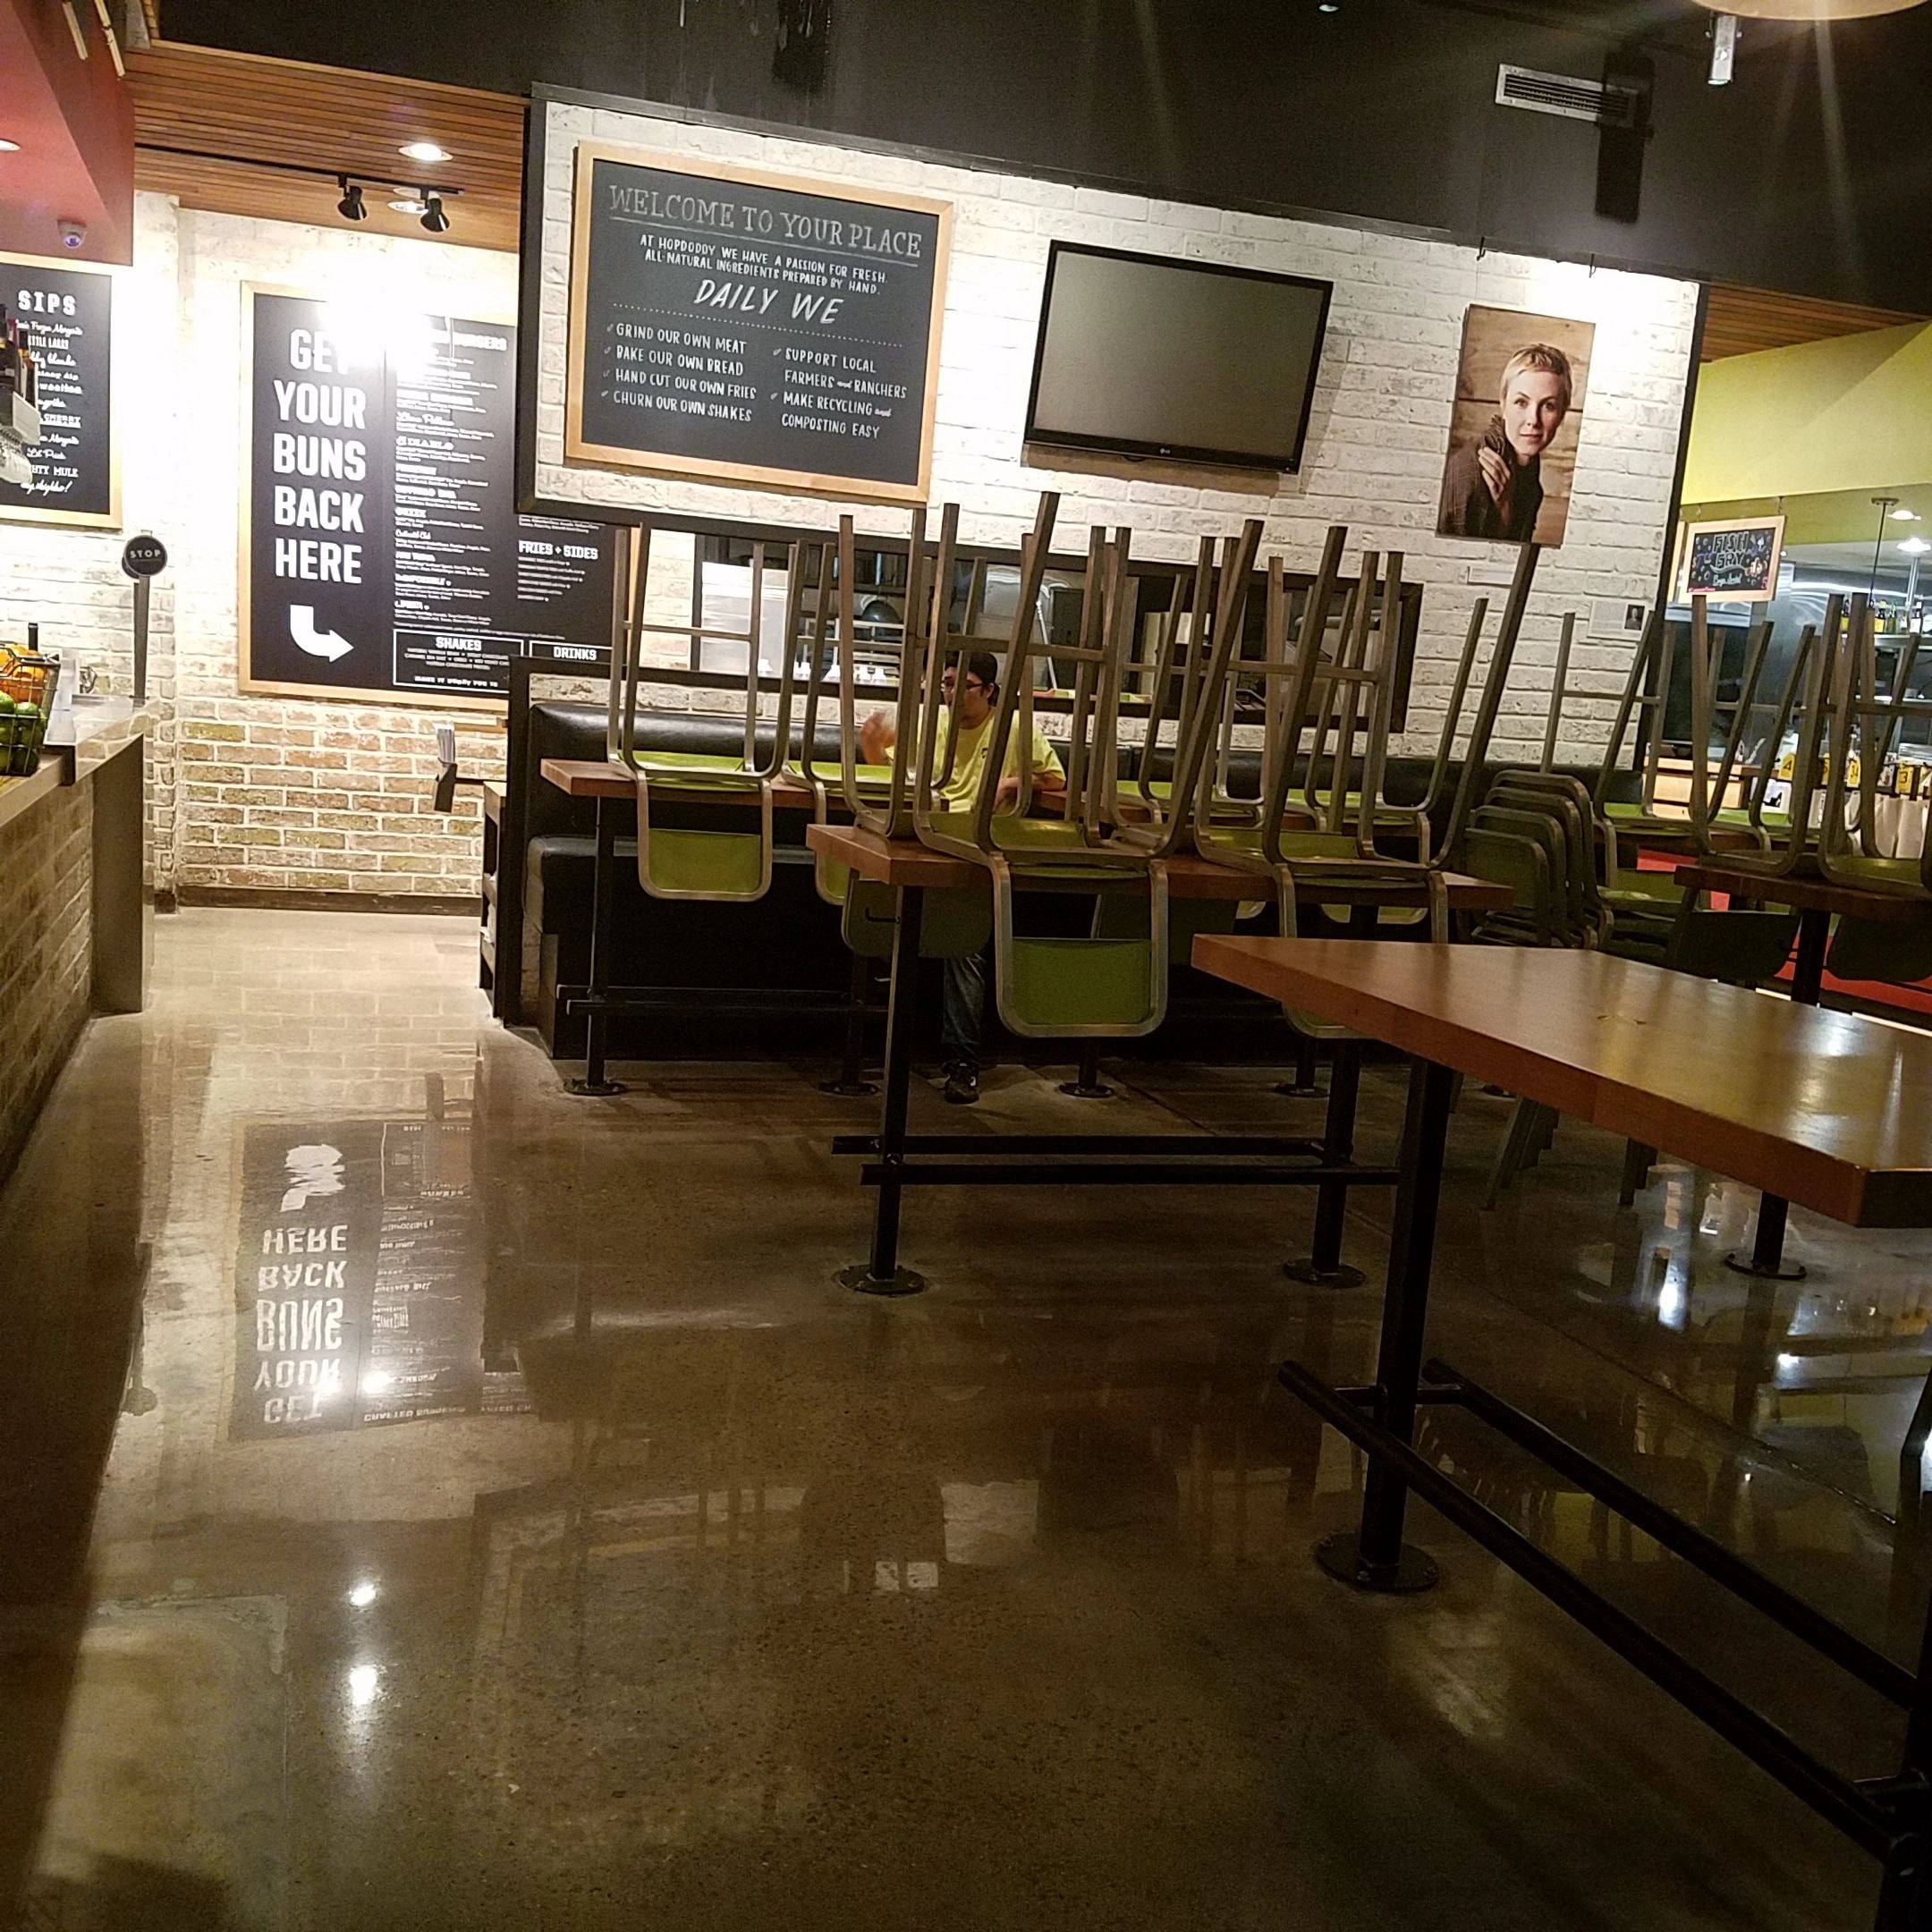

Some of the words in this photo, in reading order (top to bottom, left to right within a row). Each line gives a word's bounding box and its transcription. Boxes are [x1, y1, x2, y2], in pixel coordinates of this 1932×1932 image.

[609, 184, 735, 228] WELCOME
[741, 205, 773, 233] TO
[780, 212, 843, 246] YOUR
[848, 223, 922, 258] PLACE
[640, 233, 655, 247] AT
[658, 237, 716, 256] HOPDODDY
[721, 246, 738, 260] WE
[741, 250, 768, 265] HAVE
[775, 255, 782, 267] A
[786, 257, 826, 274] PASSION
[829, 263, 848, 278] FOR
[645, 249, 713, 269] ALL-NATURAL
[716, 258, 780, 280] INGREDIENTS
[783, 270, 828, 287] PREPARED
[830, 277, 843, 289] BY
[18, 290, 76, 316] SIPS
[693, 278, 778, 316] DAILY
[792, 292, 844, 325] WE
[616, 322, 654, 340] GRIND
[657, 328, 681, 345] OUR
[683, 332, 711, 350] OWN
[715, 337, 747, 355] MEAT
[616, 344, 645, 362] BAKE
[648, 350, 673, 367] OUR
[677, 353, 704, 371] OWN
[707, 358, 744, 377] BREAD
[784, 347, 838, 368] SUPPORT
[843, 355, 877, 374] LOCAL
[615, 368, 647, 385] HAND
[649, 373, 672, 388] CUT
[674, 376, 698, 392] OUR
[699, 380, 725, 395] OWN
[727, 384, 758, 400] FRIES
[784, 369, 835, 389] FARMERS
[853, 379, 908, 400] RANCHERS
[273, 379, 366, 429] YOUR
[613, 390, 653, 409] CHURN
[656, 395, 678, 412] OUR
[680, 399, 706, 416] OWN
[707, 403, 753, 422] SHAKES
[783, 391, 814, 409] MAKE
[817, 395, 873, 417] RECYCLING
[874, 408, 893, 418] and
[781, 413, 847, 435] COMPOSTING
[852, 422, 880, 439] EASY
[53, 465, 79, 478] MULE
[273, 432, 366, 481] BUNS
[274, 485, 365, 534] BACK
[130, 549, 161, 558] STOP
[518, 539, 554, 555] FRIES
[563, 545, 598, 560] SIDES
[1712, 531, 1750, 555] FISH
[275, 537, 362, 584] HERE
[436, 636, 482, 651] SHAKES
[553, 646, 597, 661] DRINKS
[1783, 759, 1792, 771] 4
[1899, 771, 1908, 784] 3
